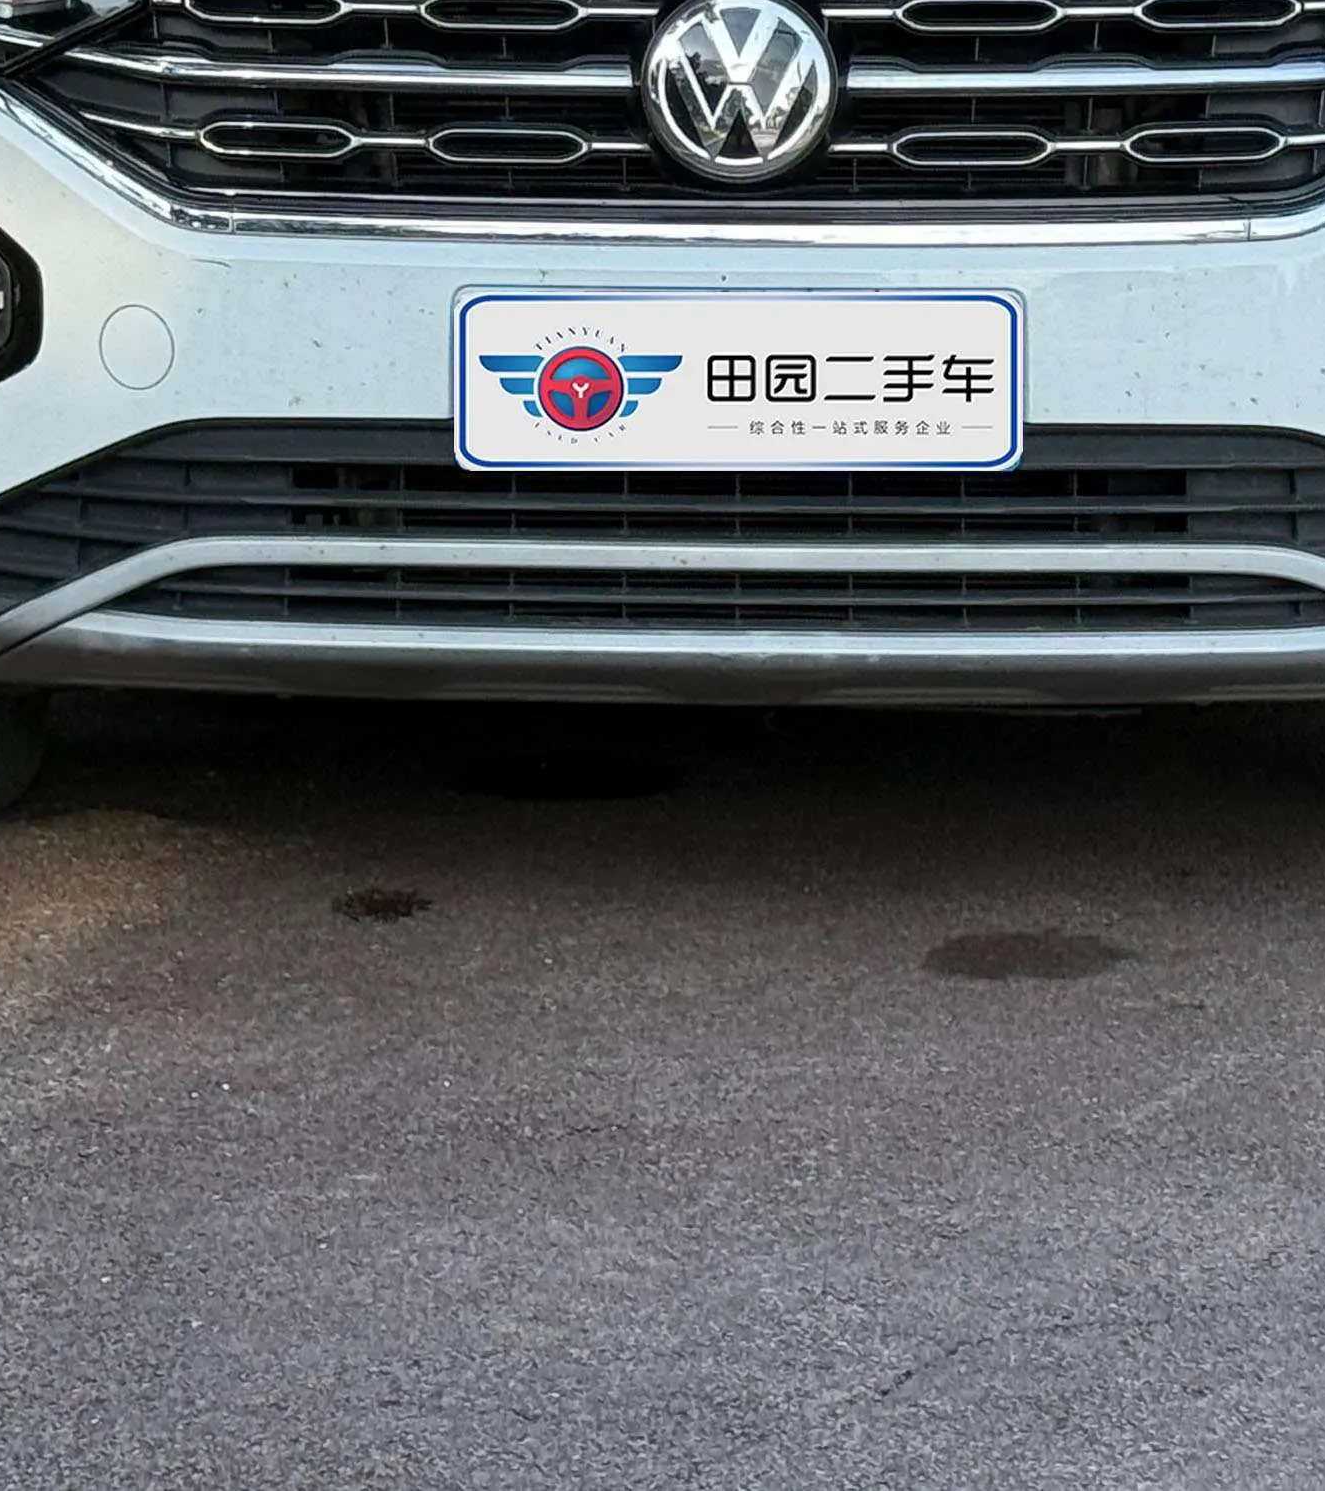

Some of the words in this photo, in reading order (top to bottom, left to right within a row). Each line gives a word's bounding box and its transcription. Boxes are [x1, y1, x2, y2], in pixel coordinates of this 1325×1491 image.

[707, 354, 995, 402] 田园二手车
[749, 419, 952, 436] 综合性一站式服务企业
